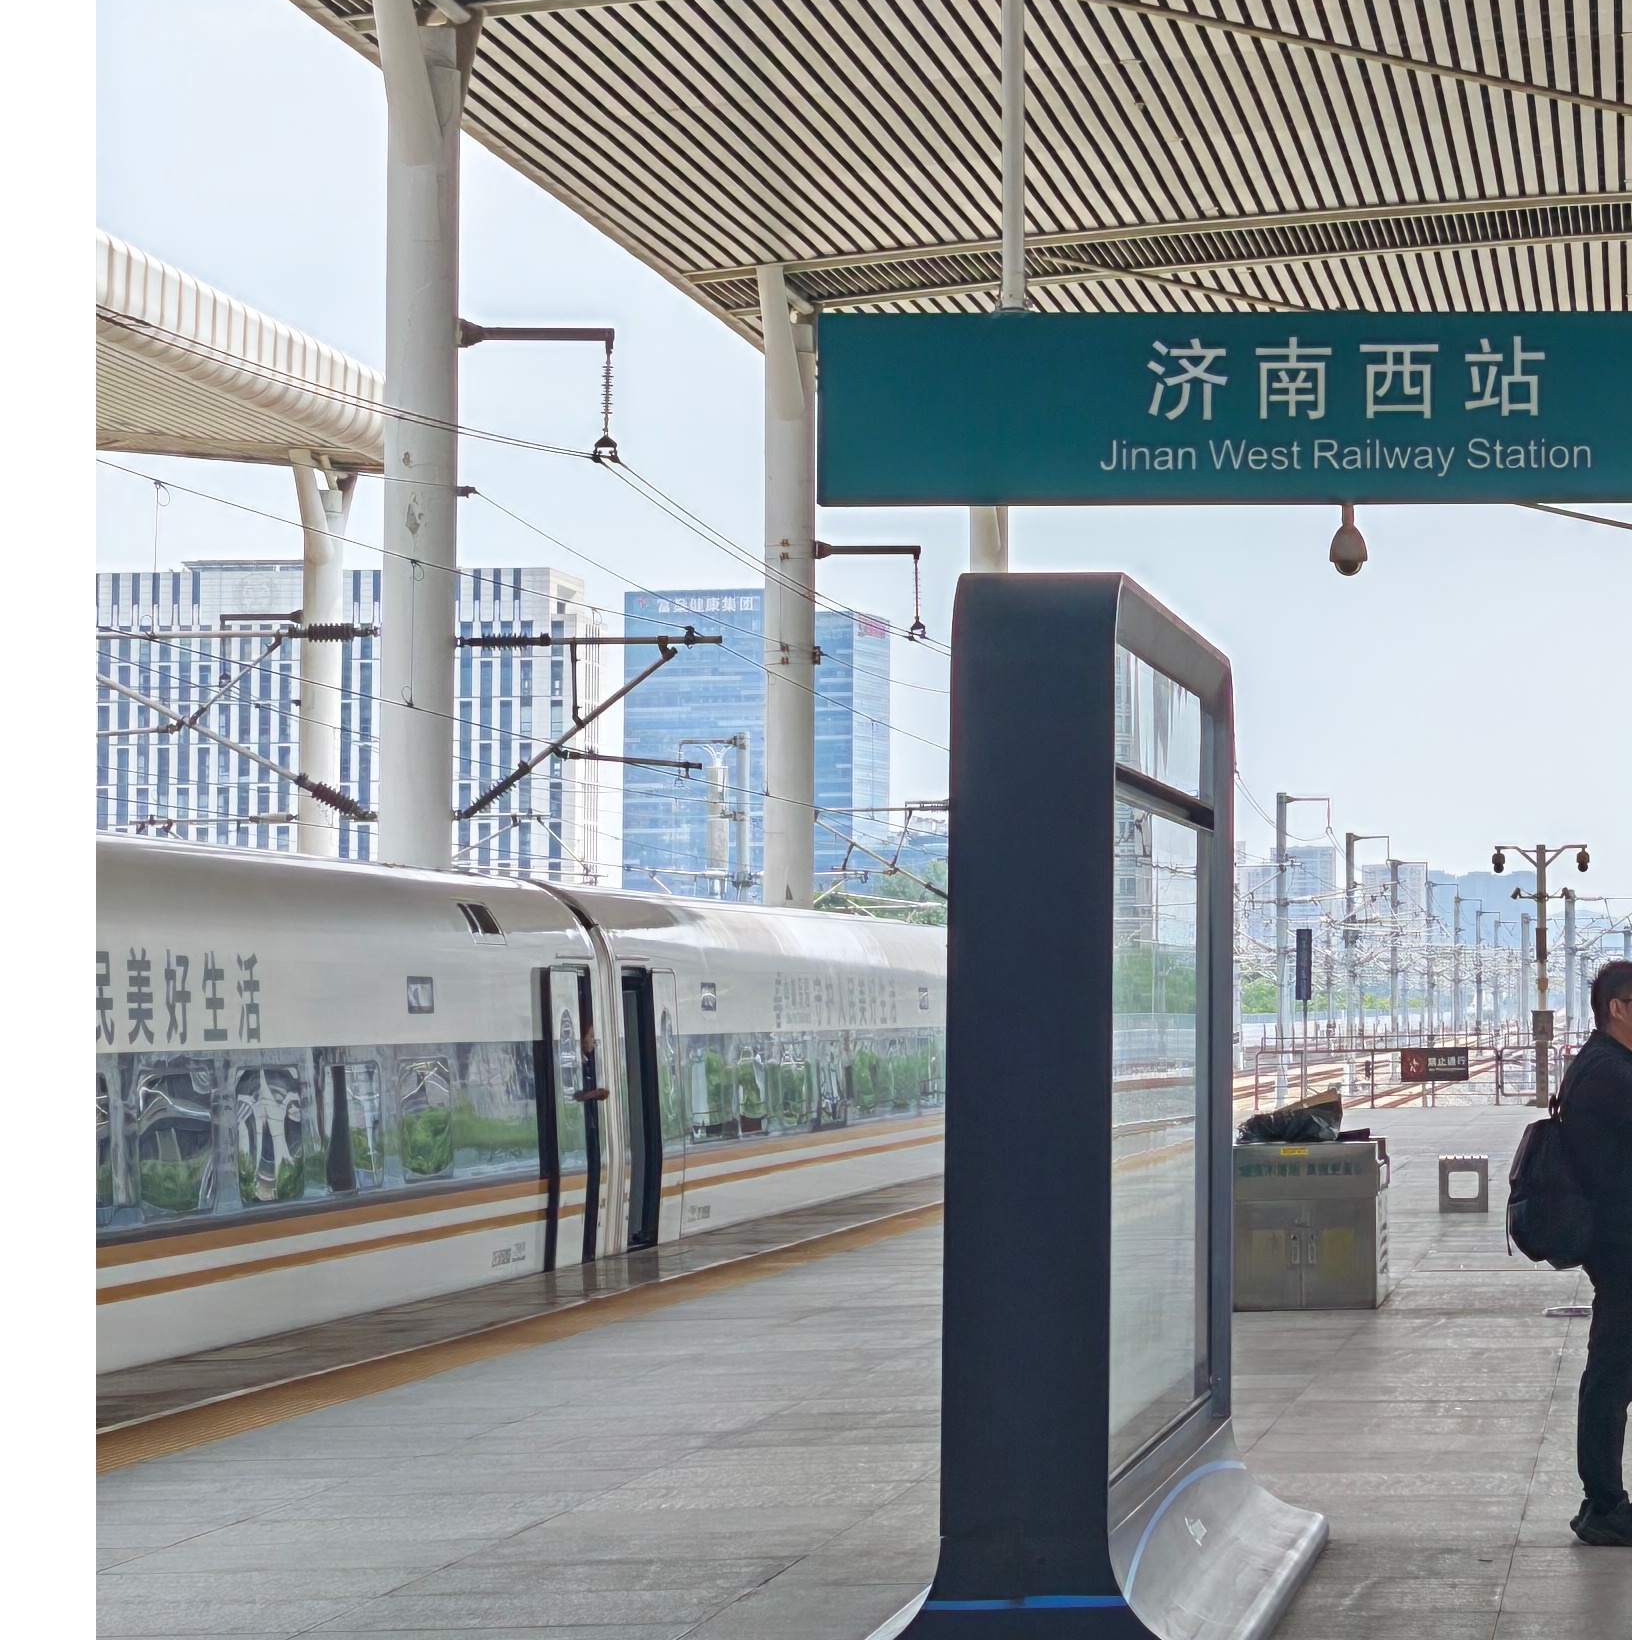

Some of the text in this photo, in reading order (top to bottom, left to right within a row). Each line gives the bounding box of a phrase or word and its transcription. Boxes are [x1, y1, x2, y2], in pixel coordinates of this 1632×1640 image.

[1148, 336, 1545, 419] 济南西站
[1101, 438, 1591, 477] Jinan West Railway Station
[96, 947, 260, 1045] 民美好生活
